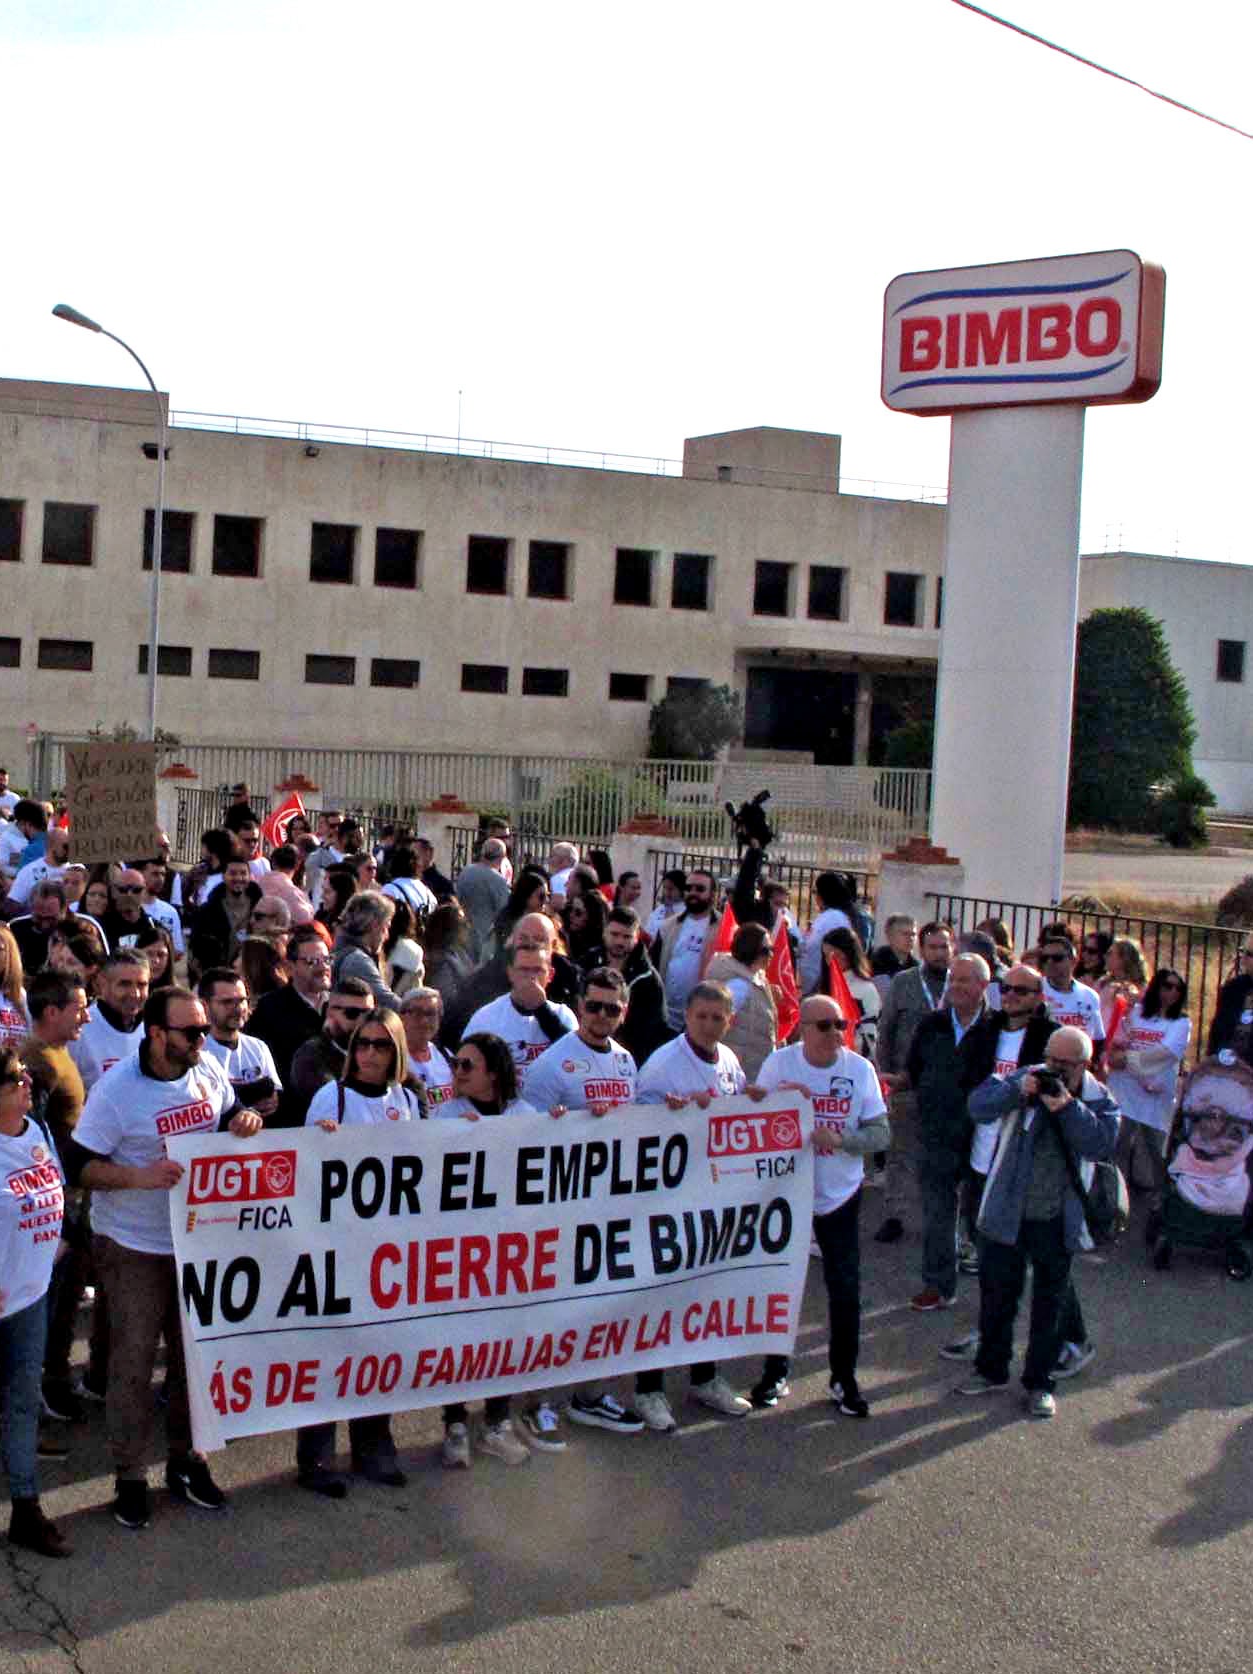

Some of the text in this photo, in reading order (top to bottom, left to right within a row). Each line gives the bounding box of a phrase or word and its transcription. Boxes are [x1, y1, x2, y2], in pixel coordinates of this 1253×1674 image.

[899, 297, 1122, 373] BIMBO
[583, 1083, 631, 1100] BIMBO
[156, 1102, 215, 1136] BIMBO
[710, 1118, 767, 1153] UGT
[193, 1159, 263, 1199] UGT
[320, 1133, 689, 1222] POR EL EMPLEO
[755, 1155, 795, 1180] FICA
[238, 1204, 294, 1231] FICA
[182, 1197, 793, 1327] NO AL CIERRE DE BIMBO
[265, 1359, 321, 1408] DE
[334, 1352, 403, 1399] 100
[410, 1328, 577, 1390] FAMILIAS
[581, 1318, 631, 1362] EN
[633, 1310, 672, 1352] LA
[682, 1293, 790, 1343] CALLE
